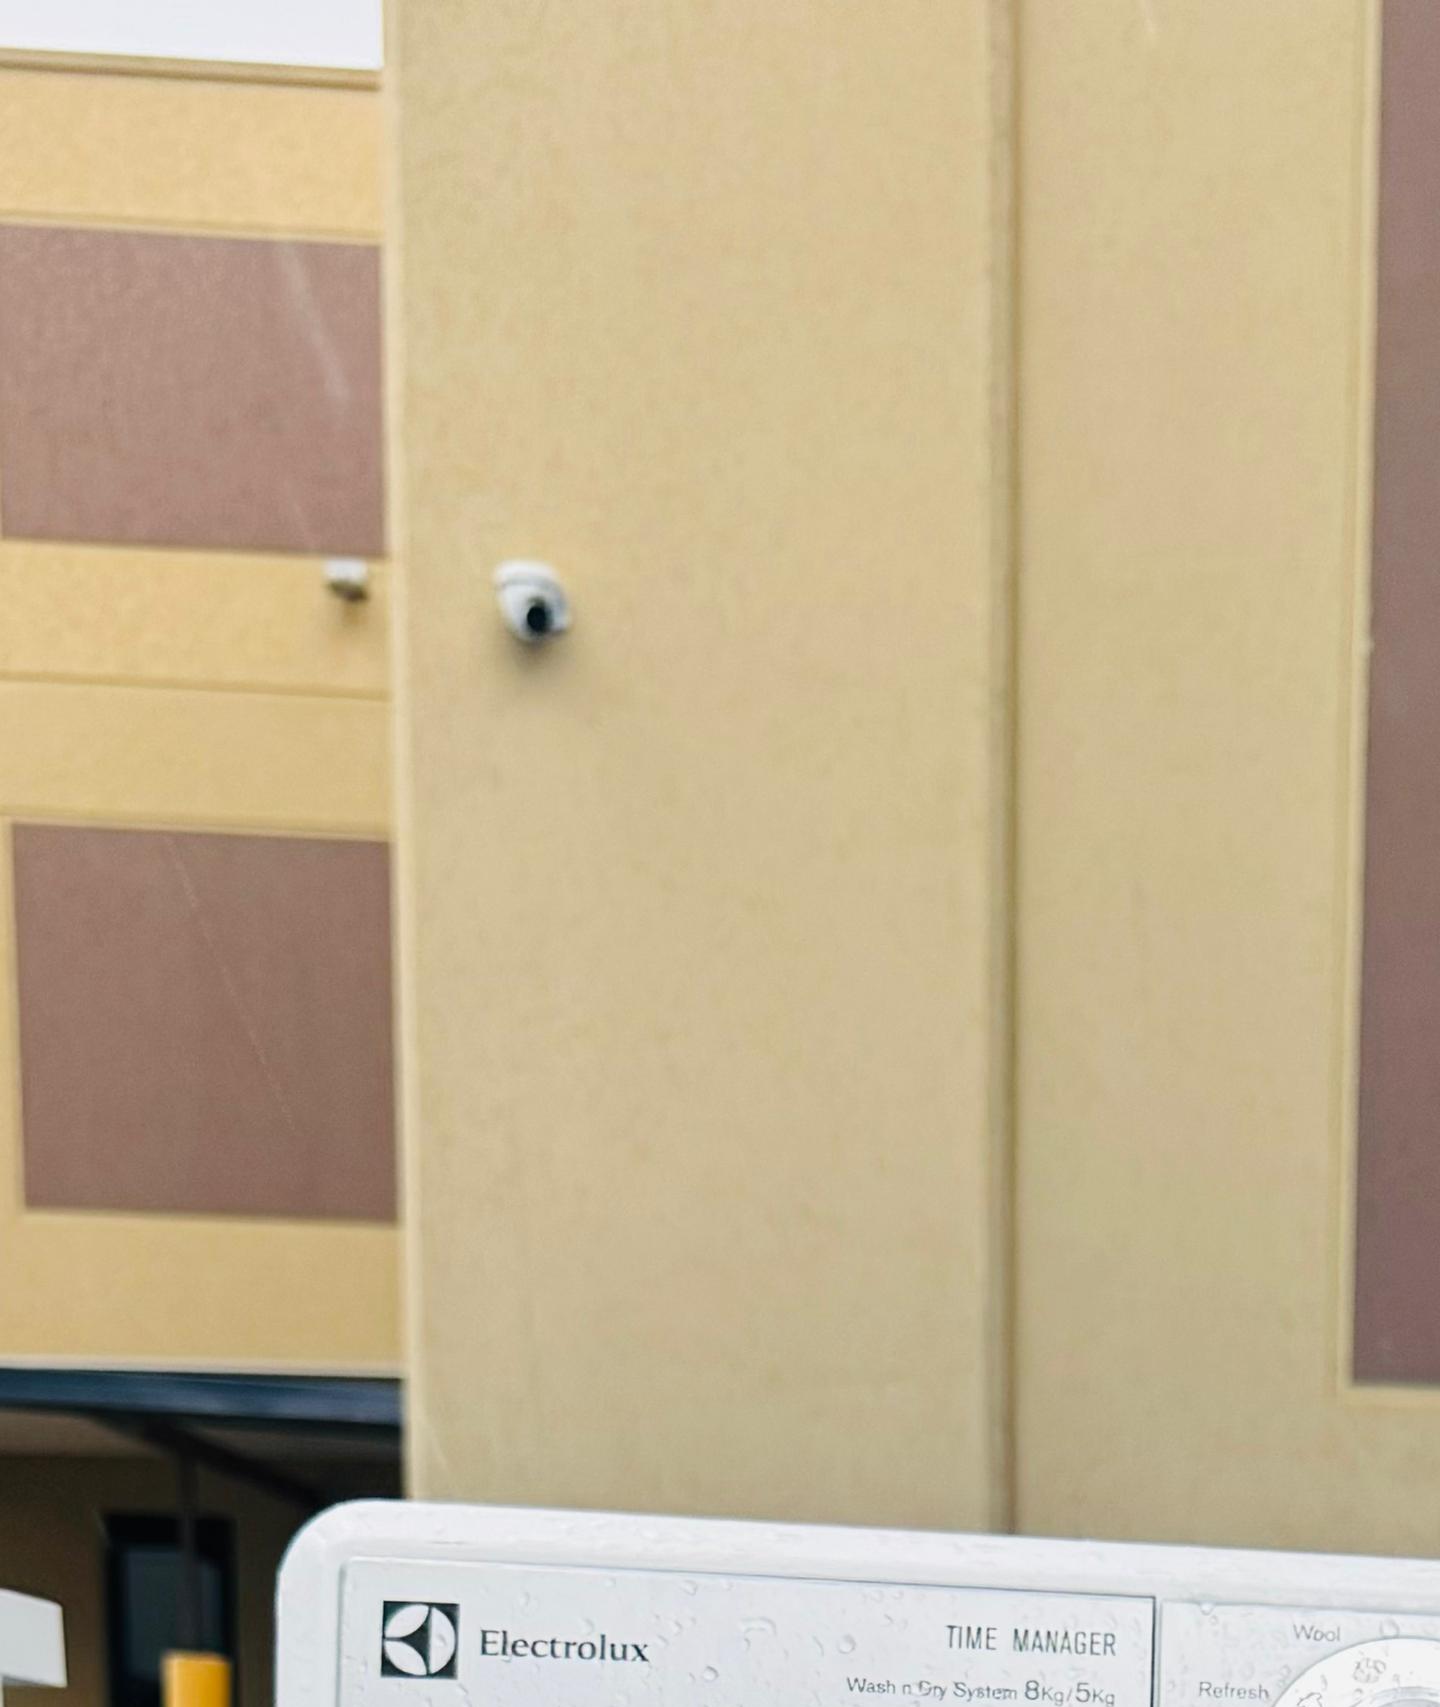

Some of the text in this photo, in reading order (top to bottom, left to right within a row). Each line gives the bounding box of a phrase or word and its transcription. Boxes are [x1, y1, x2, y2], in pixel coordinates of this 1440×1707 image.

[479, 1628, 650, 1664] Electrolux
[946, 1625, 1117, 1657] TIME MANAGER
[1293, 1623, 1341, 1644] Wool
[846, 1677, 896, 1695] Wash
[953, 1681, 1019, 1703] System
[1199, 1680, 1270, 1701] Refresh
